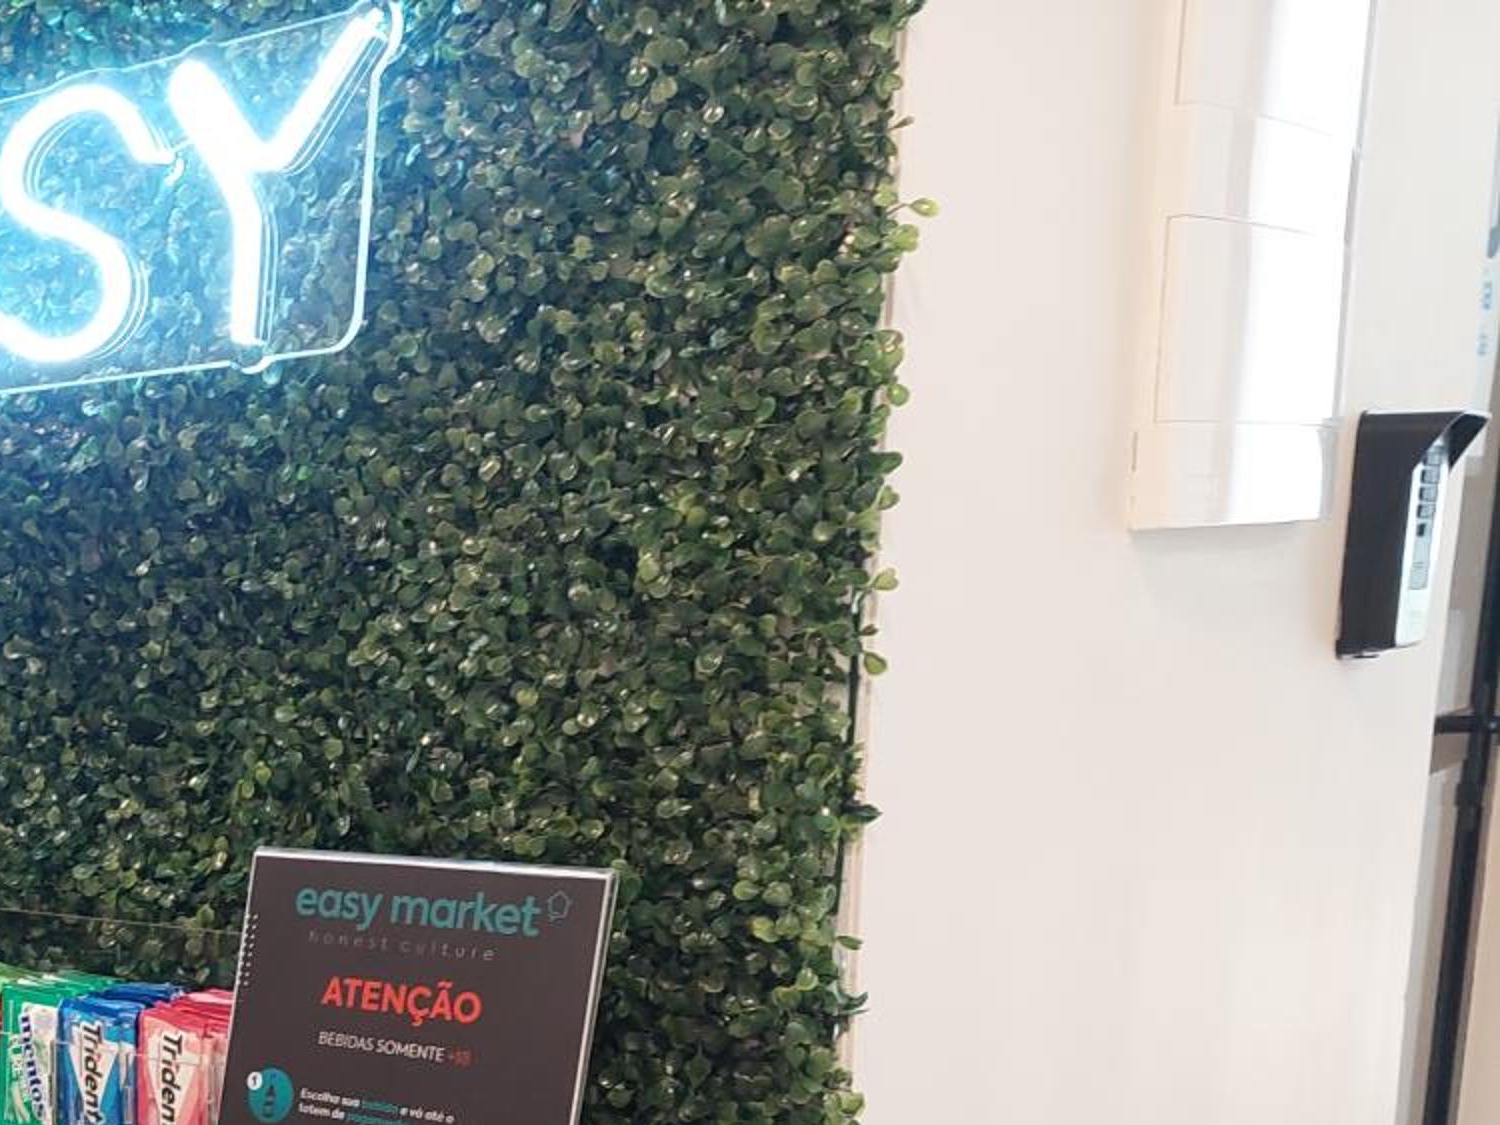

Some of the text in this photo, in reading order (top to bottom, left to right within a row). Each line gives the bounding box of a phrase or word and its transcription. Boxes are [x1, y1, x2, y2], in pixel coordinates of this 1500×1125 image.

[295, 886, 541, 938] easy market
[308, 930, 496, 962] honest culture
[321, 976, 483, 1027] ATENÇÃO
[19, 1010, 48, 1121] mentos
[317, 1031, 375, 1051] BEBIDAS
[376, 1039, 445, 1063] SOMENTE
[79, 1022, 103, 1125] Trident
